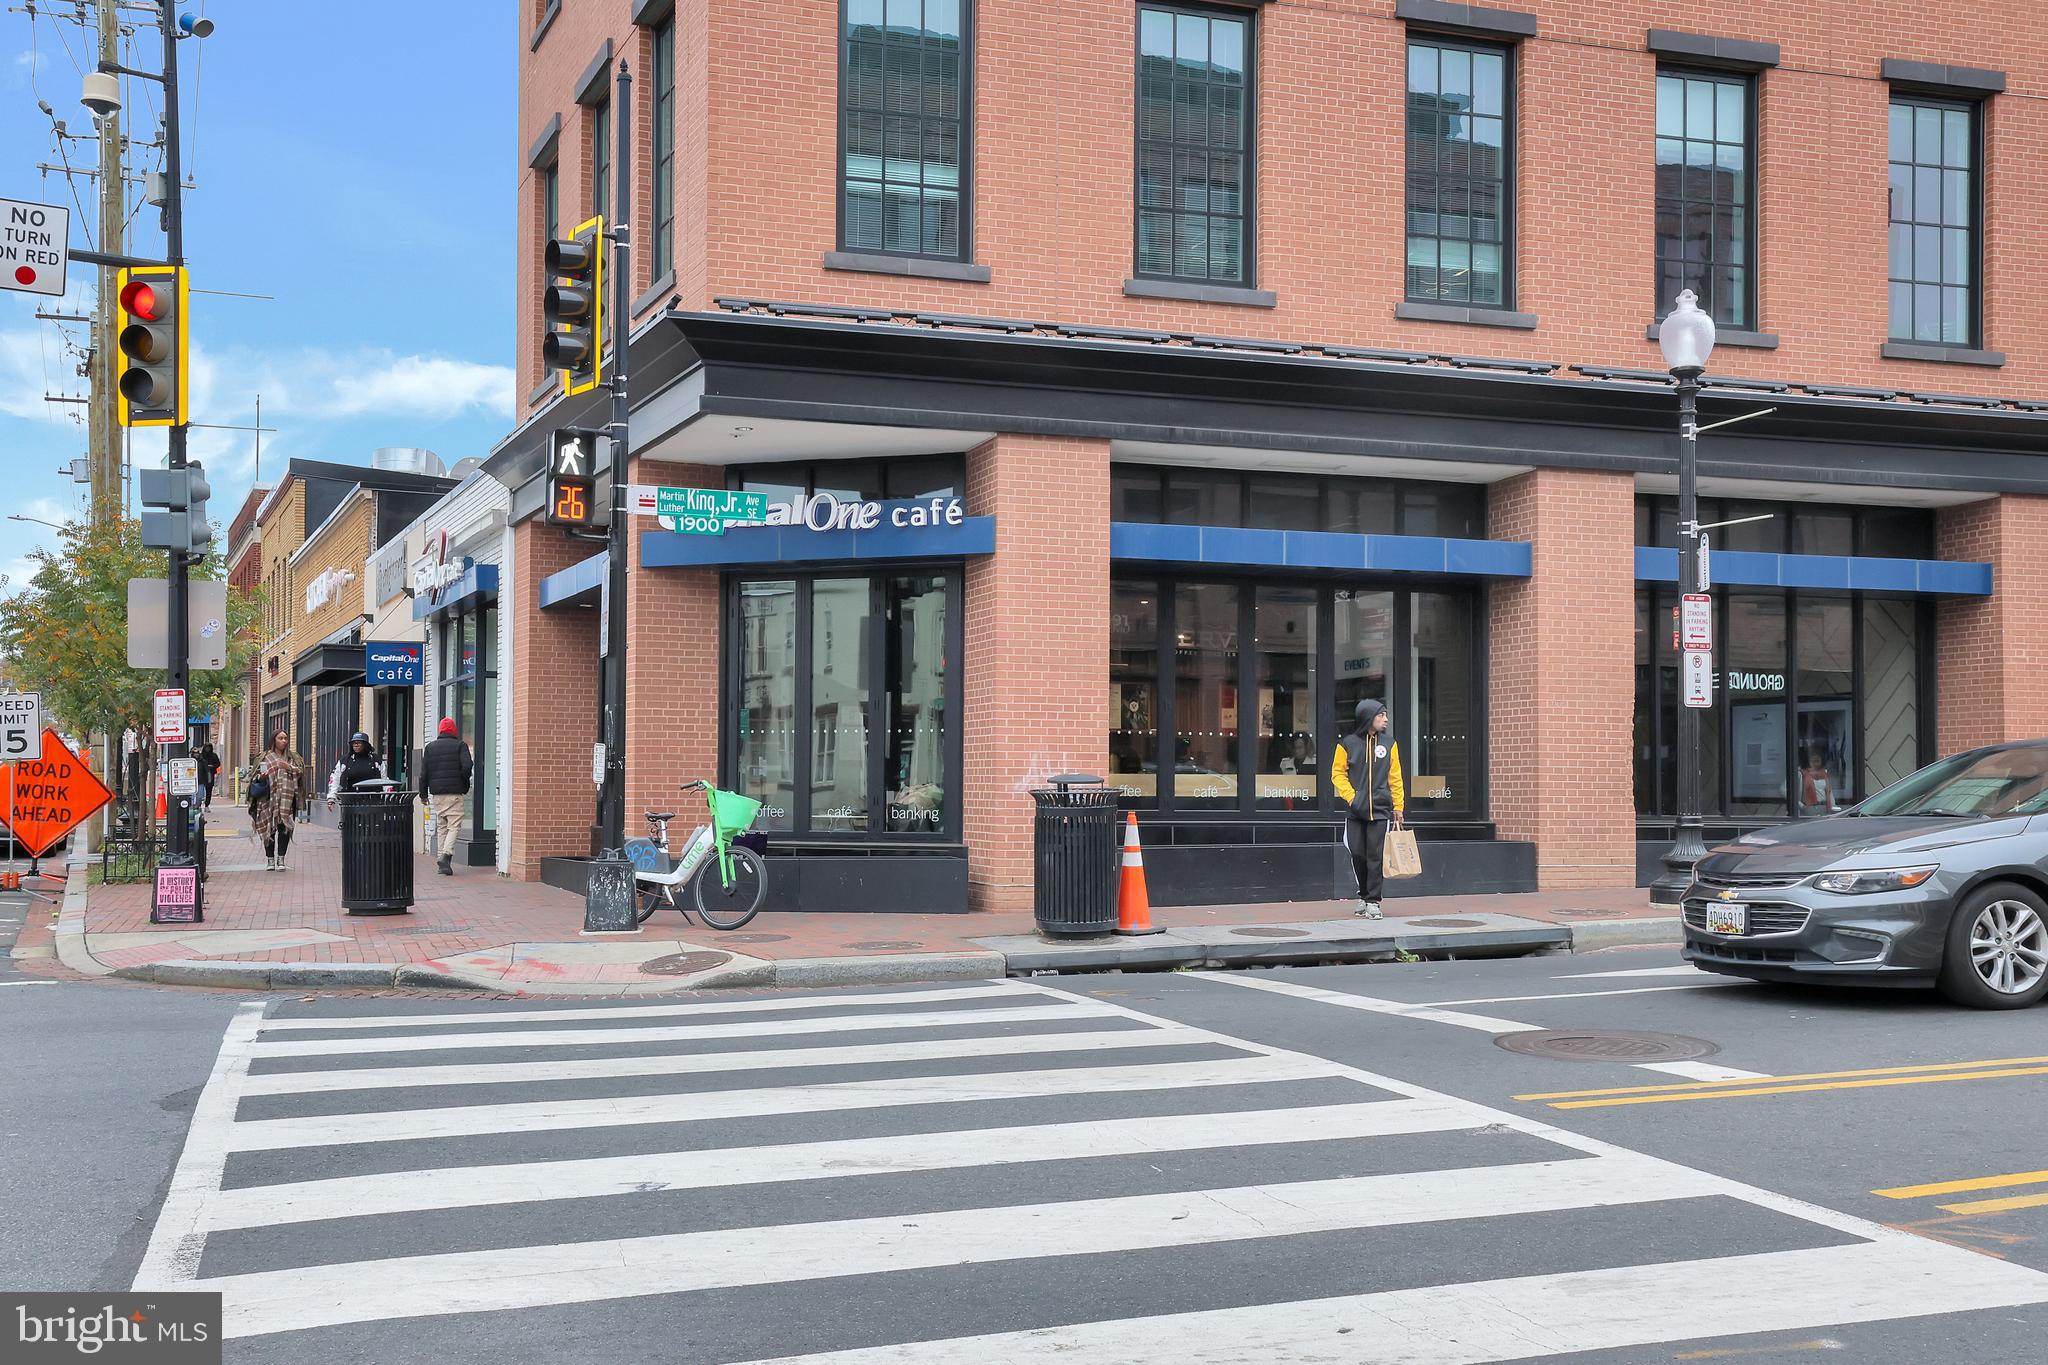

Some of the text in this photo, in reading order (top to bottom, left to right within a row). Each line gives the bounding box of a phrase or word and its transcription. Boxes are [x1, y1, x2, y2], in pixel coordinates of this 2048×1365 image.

[11, 207, 45, 226] NO
[5, 227, 51, 246] TURN
[25, 249, 60, 266] RED
[557, 485, 584, 519] 26
[660, 490, 685, 501] Martin
[687, 488, 742, 518] King, Jr.
[745, 494, 760, 506] Ave
[659, 502, 685, 513] Luther
[747, 507, 758, 519] SE
[891, 497, 963, 527] café
[679, 516, 720, 533] 1900
[377, 666, 413, 680] café
[17, 761, 71, 779] ROAD
[17, 784, 70, 801] WORK
[1193, 784, 1219, 798] café
[1264, 785, 1310, 801] banking
[1428, 786, 1452, 799] café
[8, 805, 72, 823] AHEAD
[827, 805, 852, 818] café
[891, 806, 940, 822] banking
[160, 877, 194, 886] A HISTORY
[170, 886, 193, 894] POLICE
[160, 895, 193, 903] VIOLENCE
